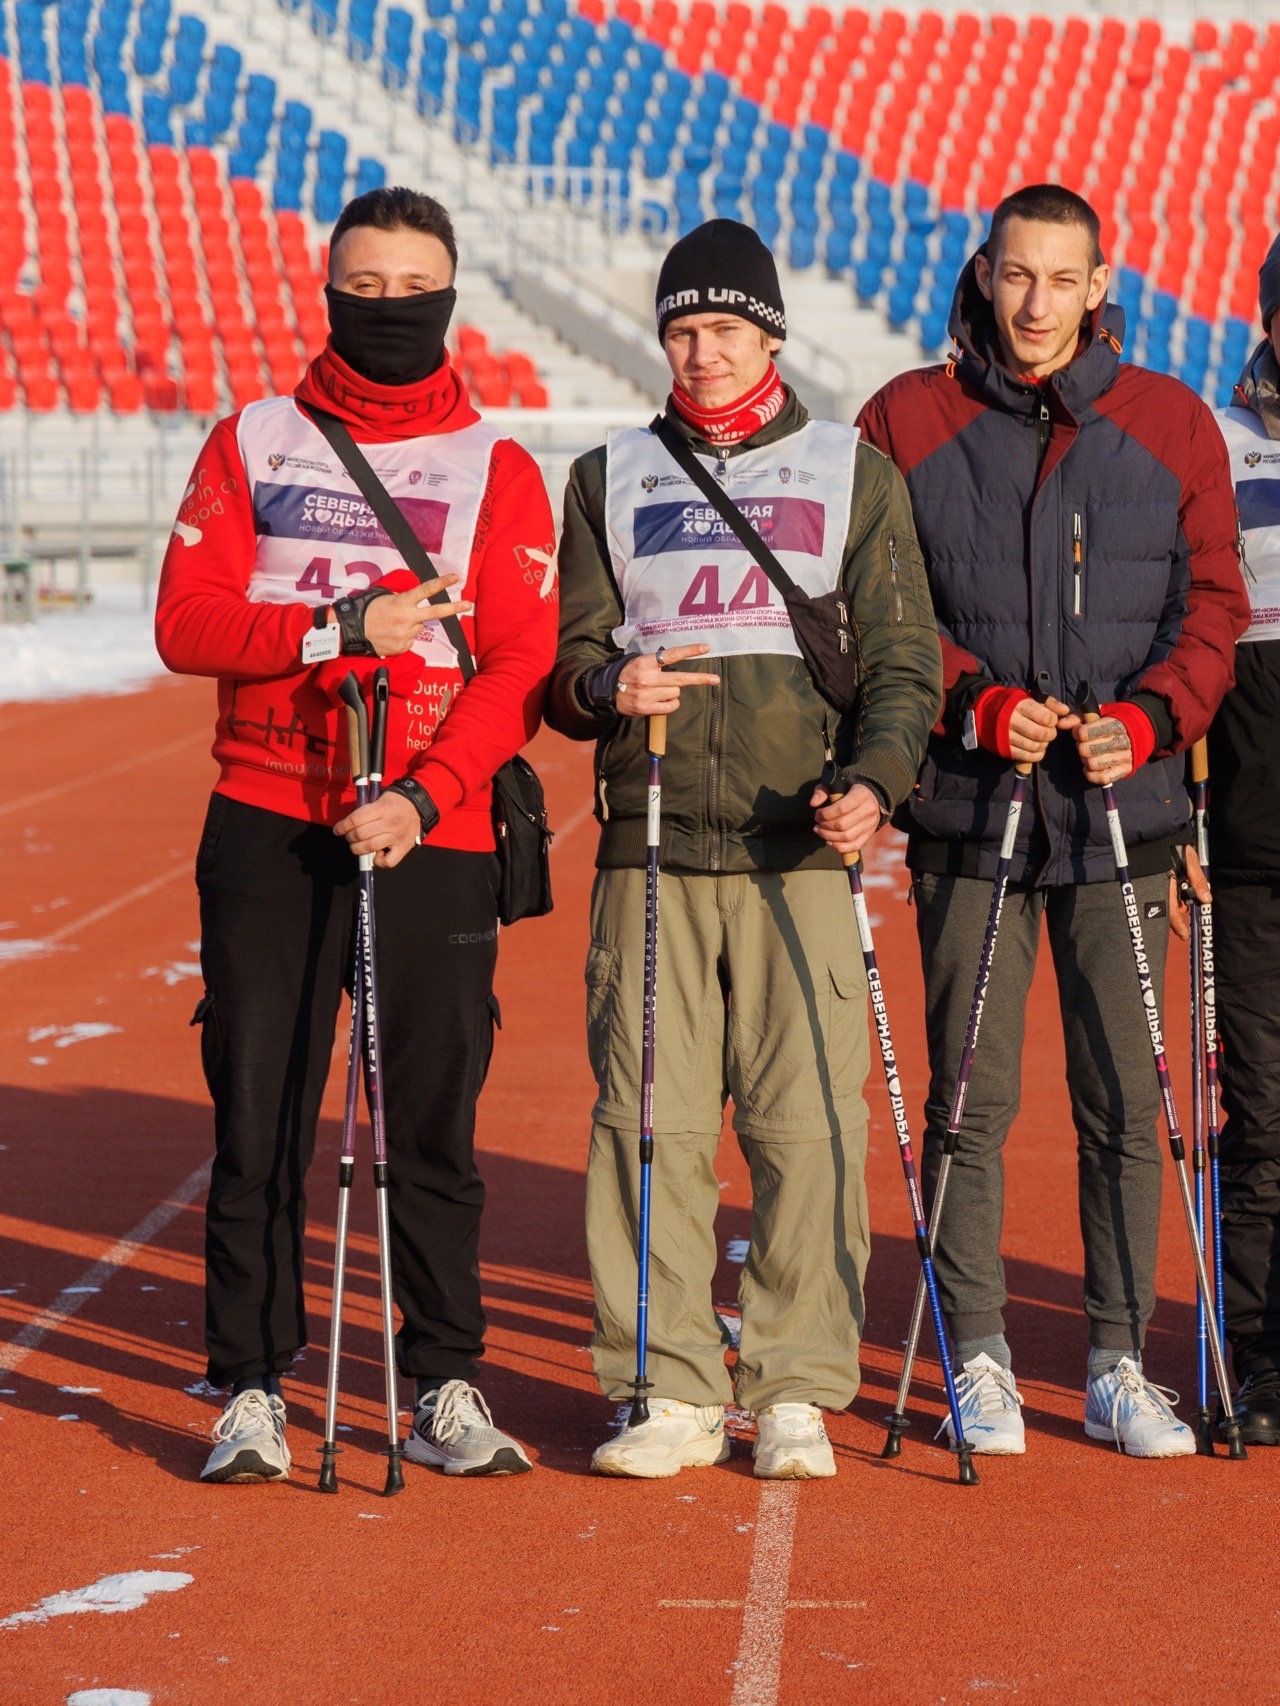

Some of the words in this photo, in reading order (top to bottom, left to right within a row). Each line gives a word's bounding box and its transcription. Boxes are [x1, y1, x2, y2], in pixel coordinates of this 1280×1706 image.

[657, 288, 699, 319] ARM
[707, 287, 747, 304] UP
[304, 494, 375, 517] СЕВЕРН
[682, 504, 774, 520] СЕВНАЯ
[678, 565, 776, 617] 44
[406, 700, 423, 715] to
[1121, 882, 1149, 974] СЕВЕРНАЯ
[1201, 884, 1214, 972] ВЕРНАЯ
[644, 932, 652, 982] ОБРАЗ
[643, 995, 652, 1048] ЖИЗНИ
[867, 967, 895, 1061] СЕВЕРНАЯ
